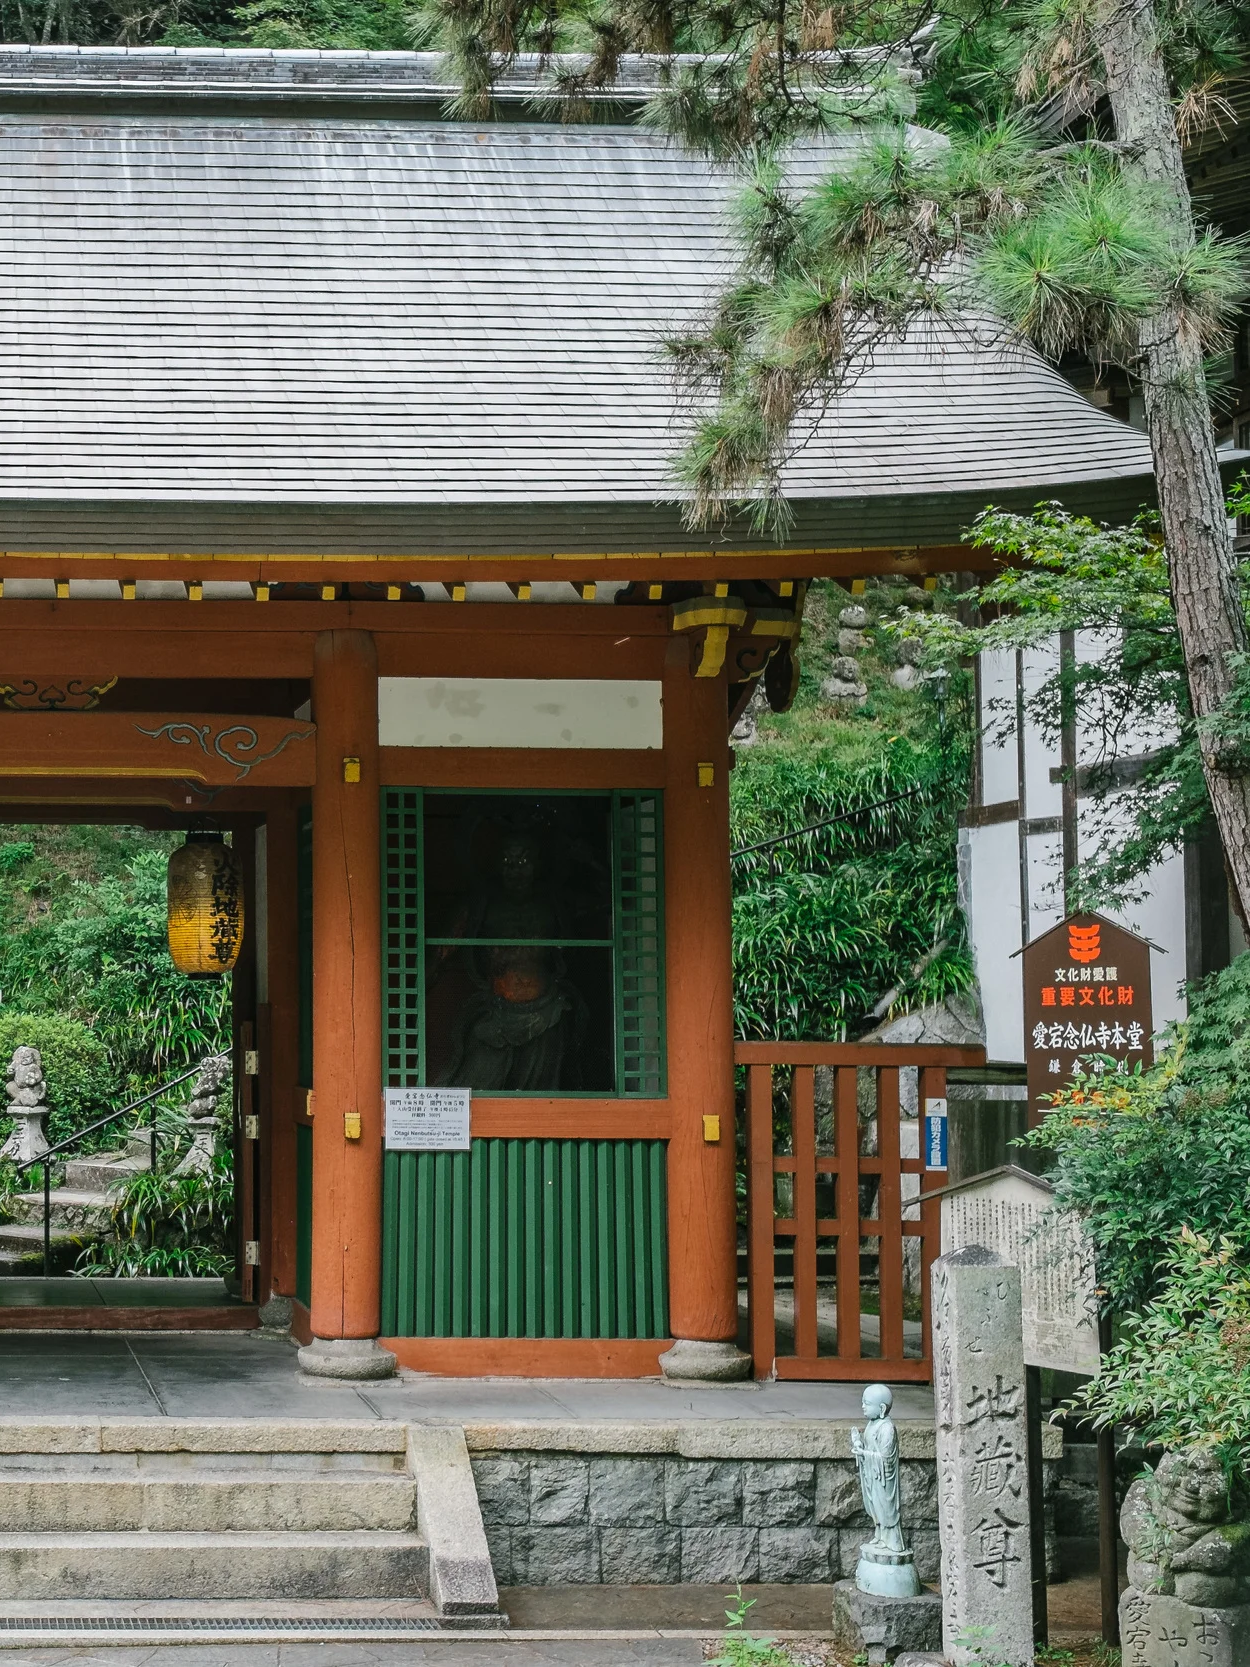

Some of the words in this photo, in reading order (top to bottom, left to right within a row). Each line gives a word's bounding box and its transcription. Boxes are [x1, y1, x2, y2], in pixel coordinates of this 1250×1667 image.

[1054, 966, 1118, 982] 文化財愛護
[1041, 985, 1134, 1006] 重要文化財
[1032, 1020, 1145, 1050] 愛宕念仏寺本堂
